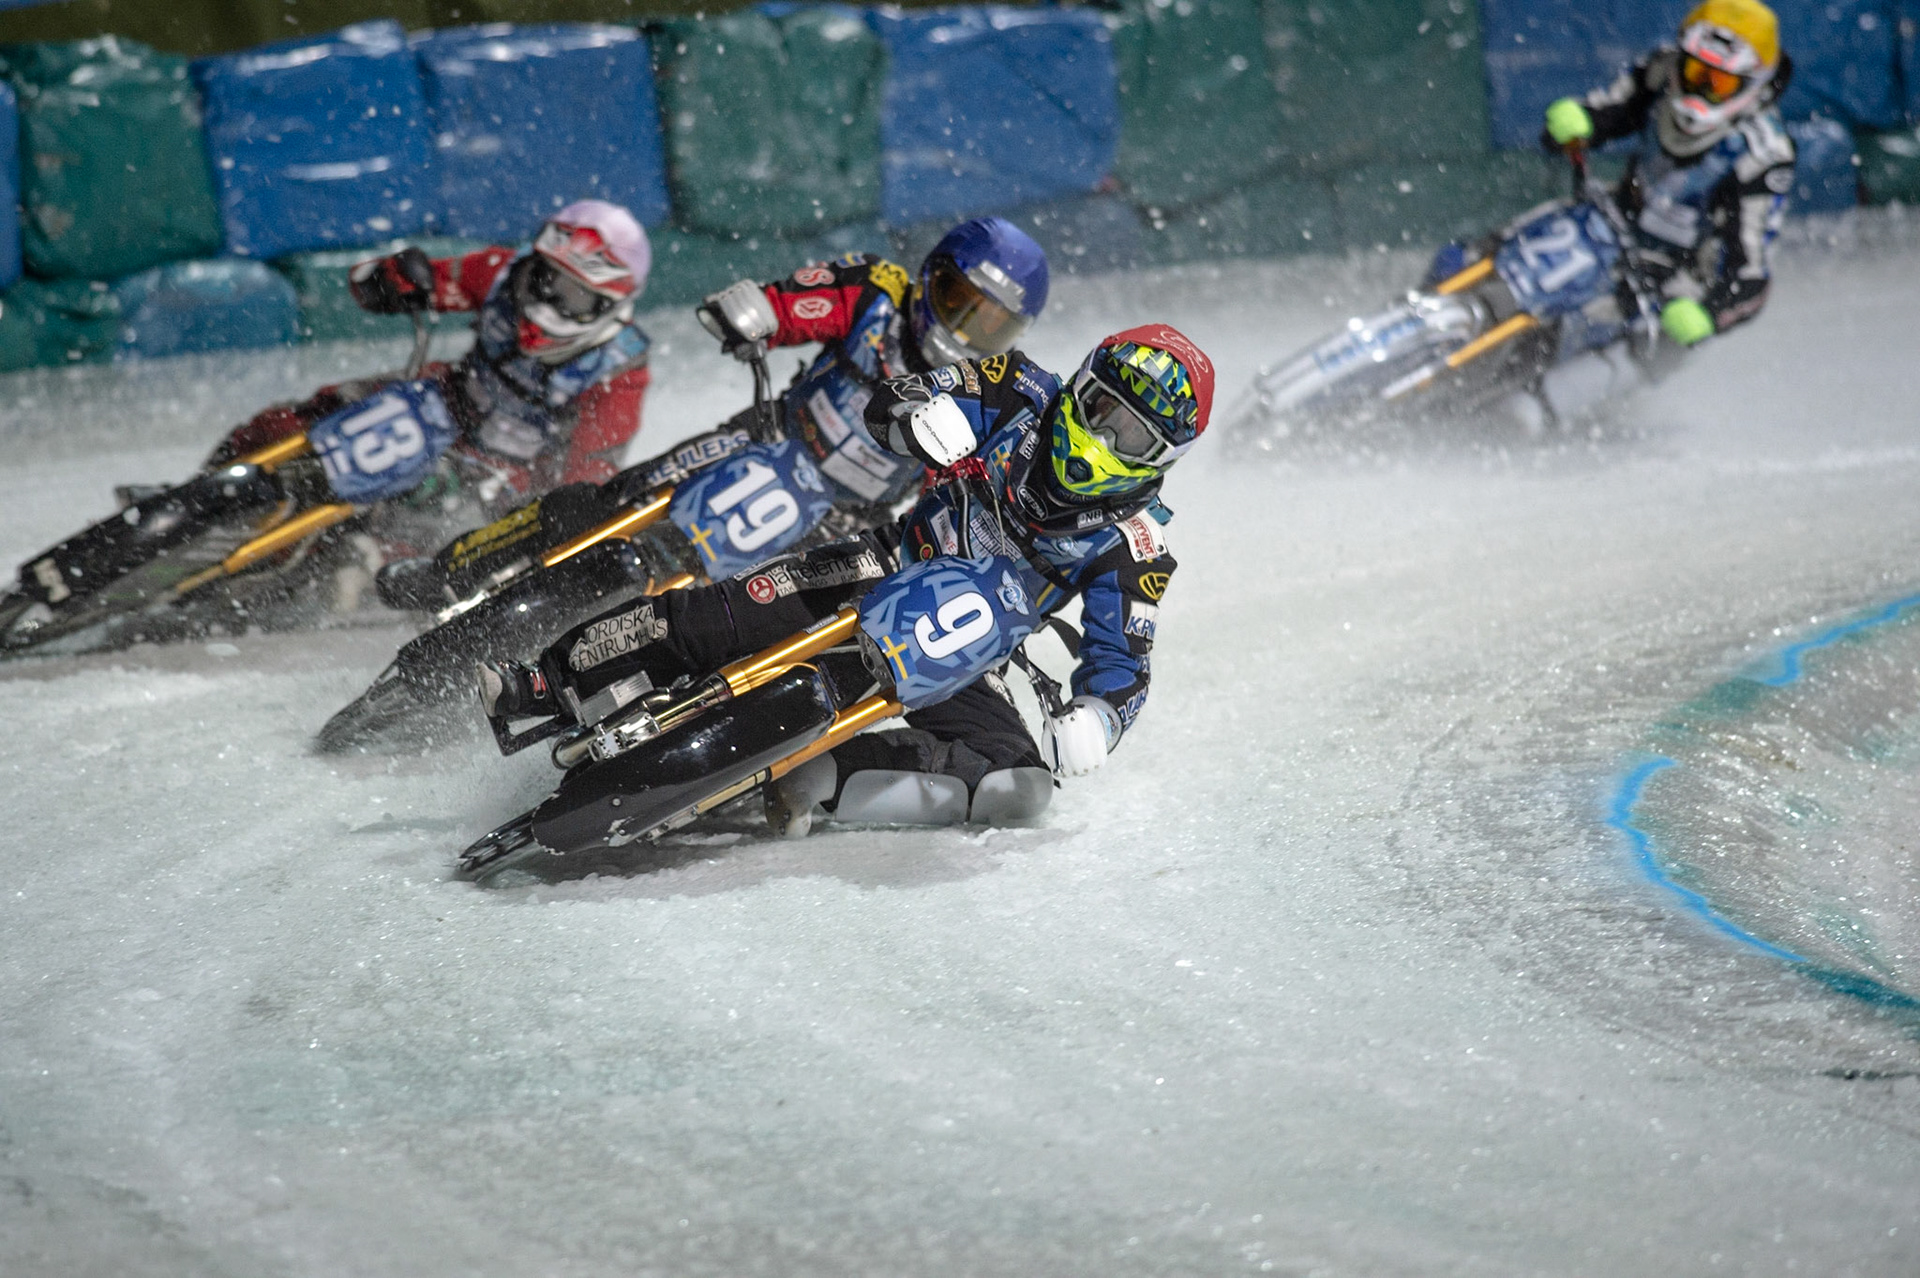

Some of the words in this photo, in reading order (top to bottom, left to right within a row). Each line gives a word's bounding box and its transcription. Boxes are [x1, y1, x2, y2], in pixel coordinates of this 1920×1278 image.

[1517, 216, 1597, 293] 21
[340, 394, 426, 474] 13
[708, 461, 800, 553] 19
[578, 604, 654, 645] ORDISKA
[778, 585, 795, 596] TAK
[914, 591, 995, 660] 9
